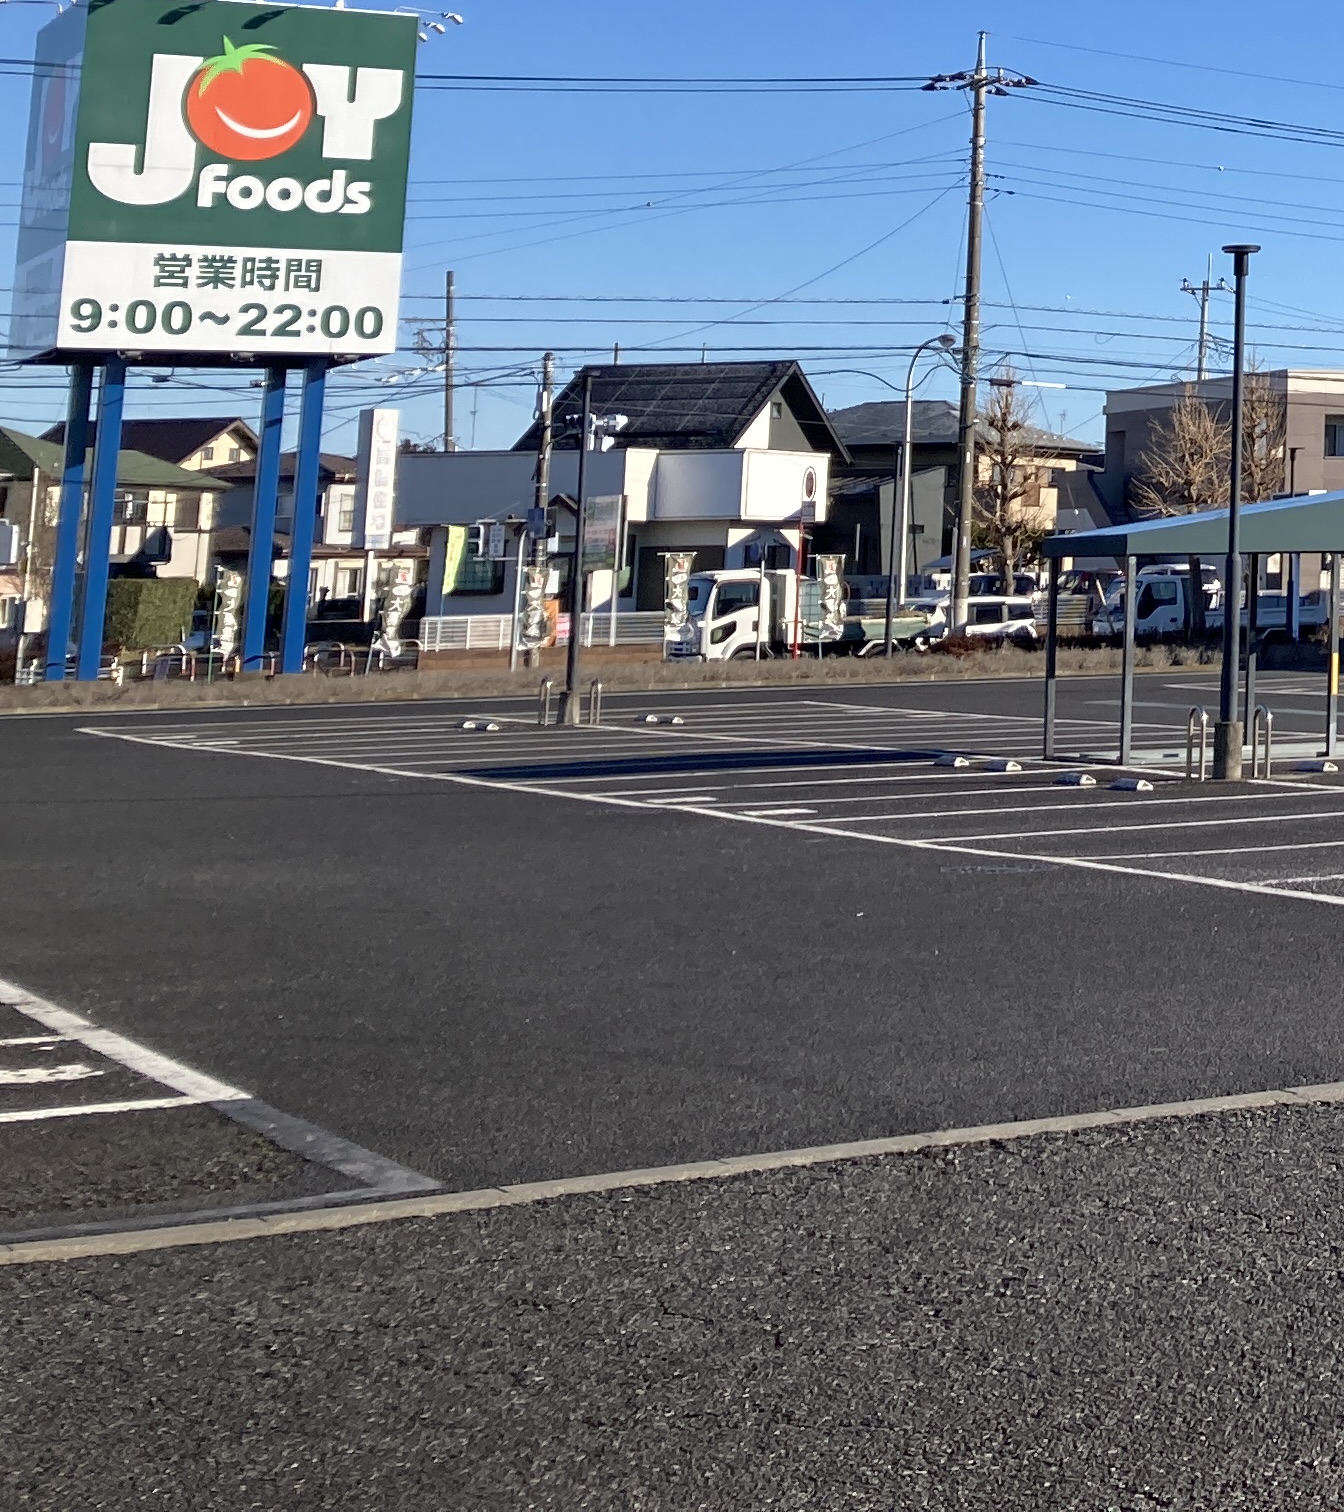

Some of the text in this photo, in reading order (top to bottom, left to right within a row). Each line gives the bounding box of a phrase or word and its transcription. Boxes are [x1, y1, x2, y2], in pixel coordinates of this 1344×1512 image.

[88, 35, 404, 206] JOY
[196, 163, 371, 214] foods
[152, 252, 323, 293] 営業時間
